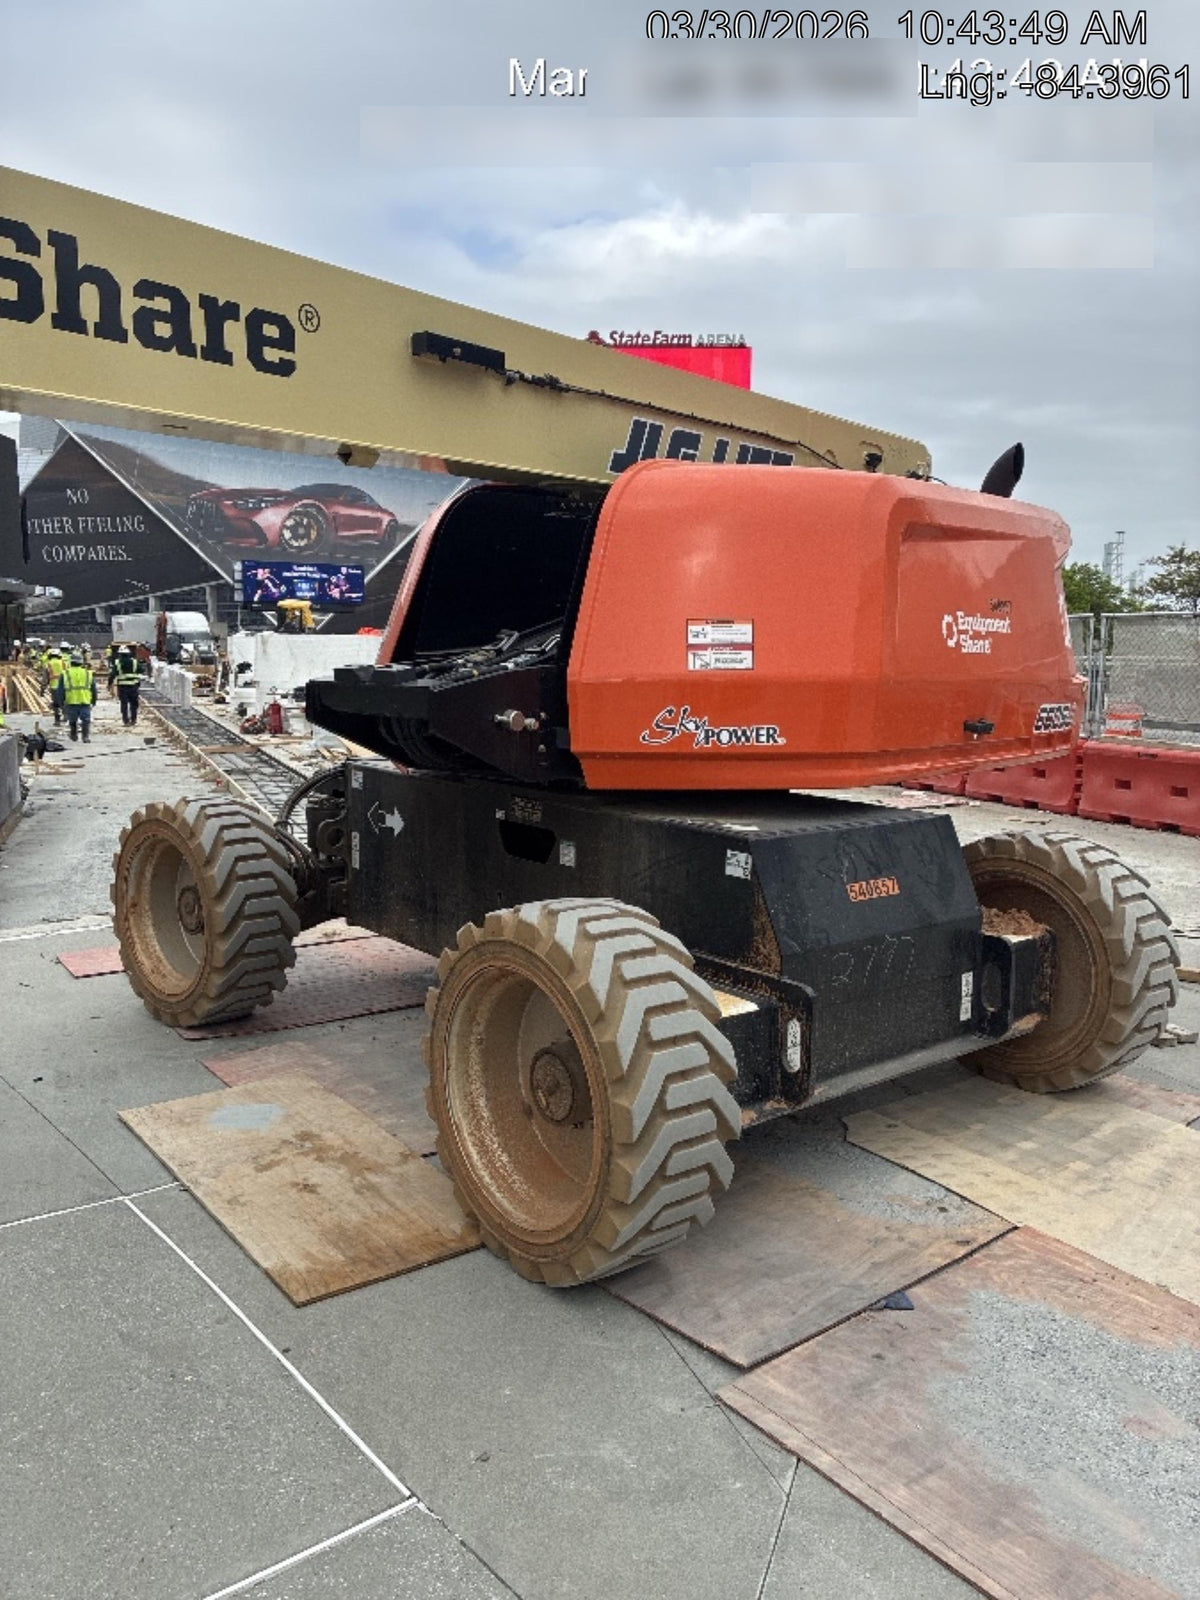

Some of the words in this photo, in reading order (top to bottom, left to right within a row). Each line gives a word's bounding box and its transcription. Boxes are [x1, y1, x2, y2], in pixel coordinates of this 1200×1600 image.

[696, 333, 747, 348] ARENA
[66, 488, 90, 505] NO
[956, 611, 1012, 636] Equipment
[640, 705, 708, 749] Sky
[702, 725, 781, 747] POWER
